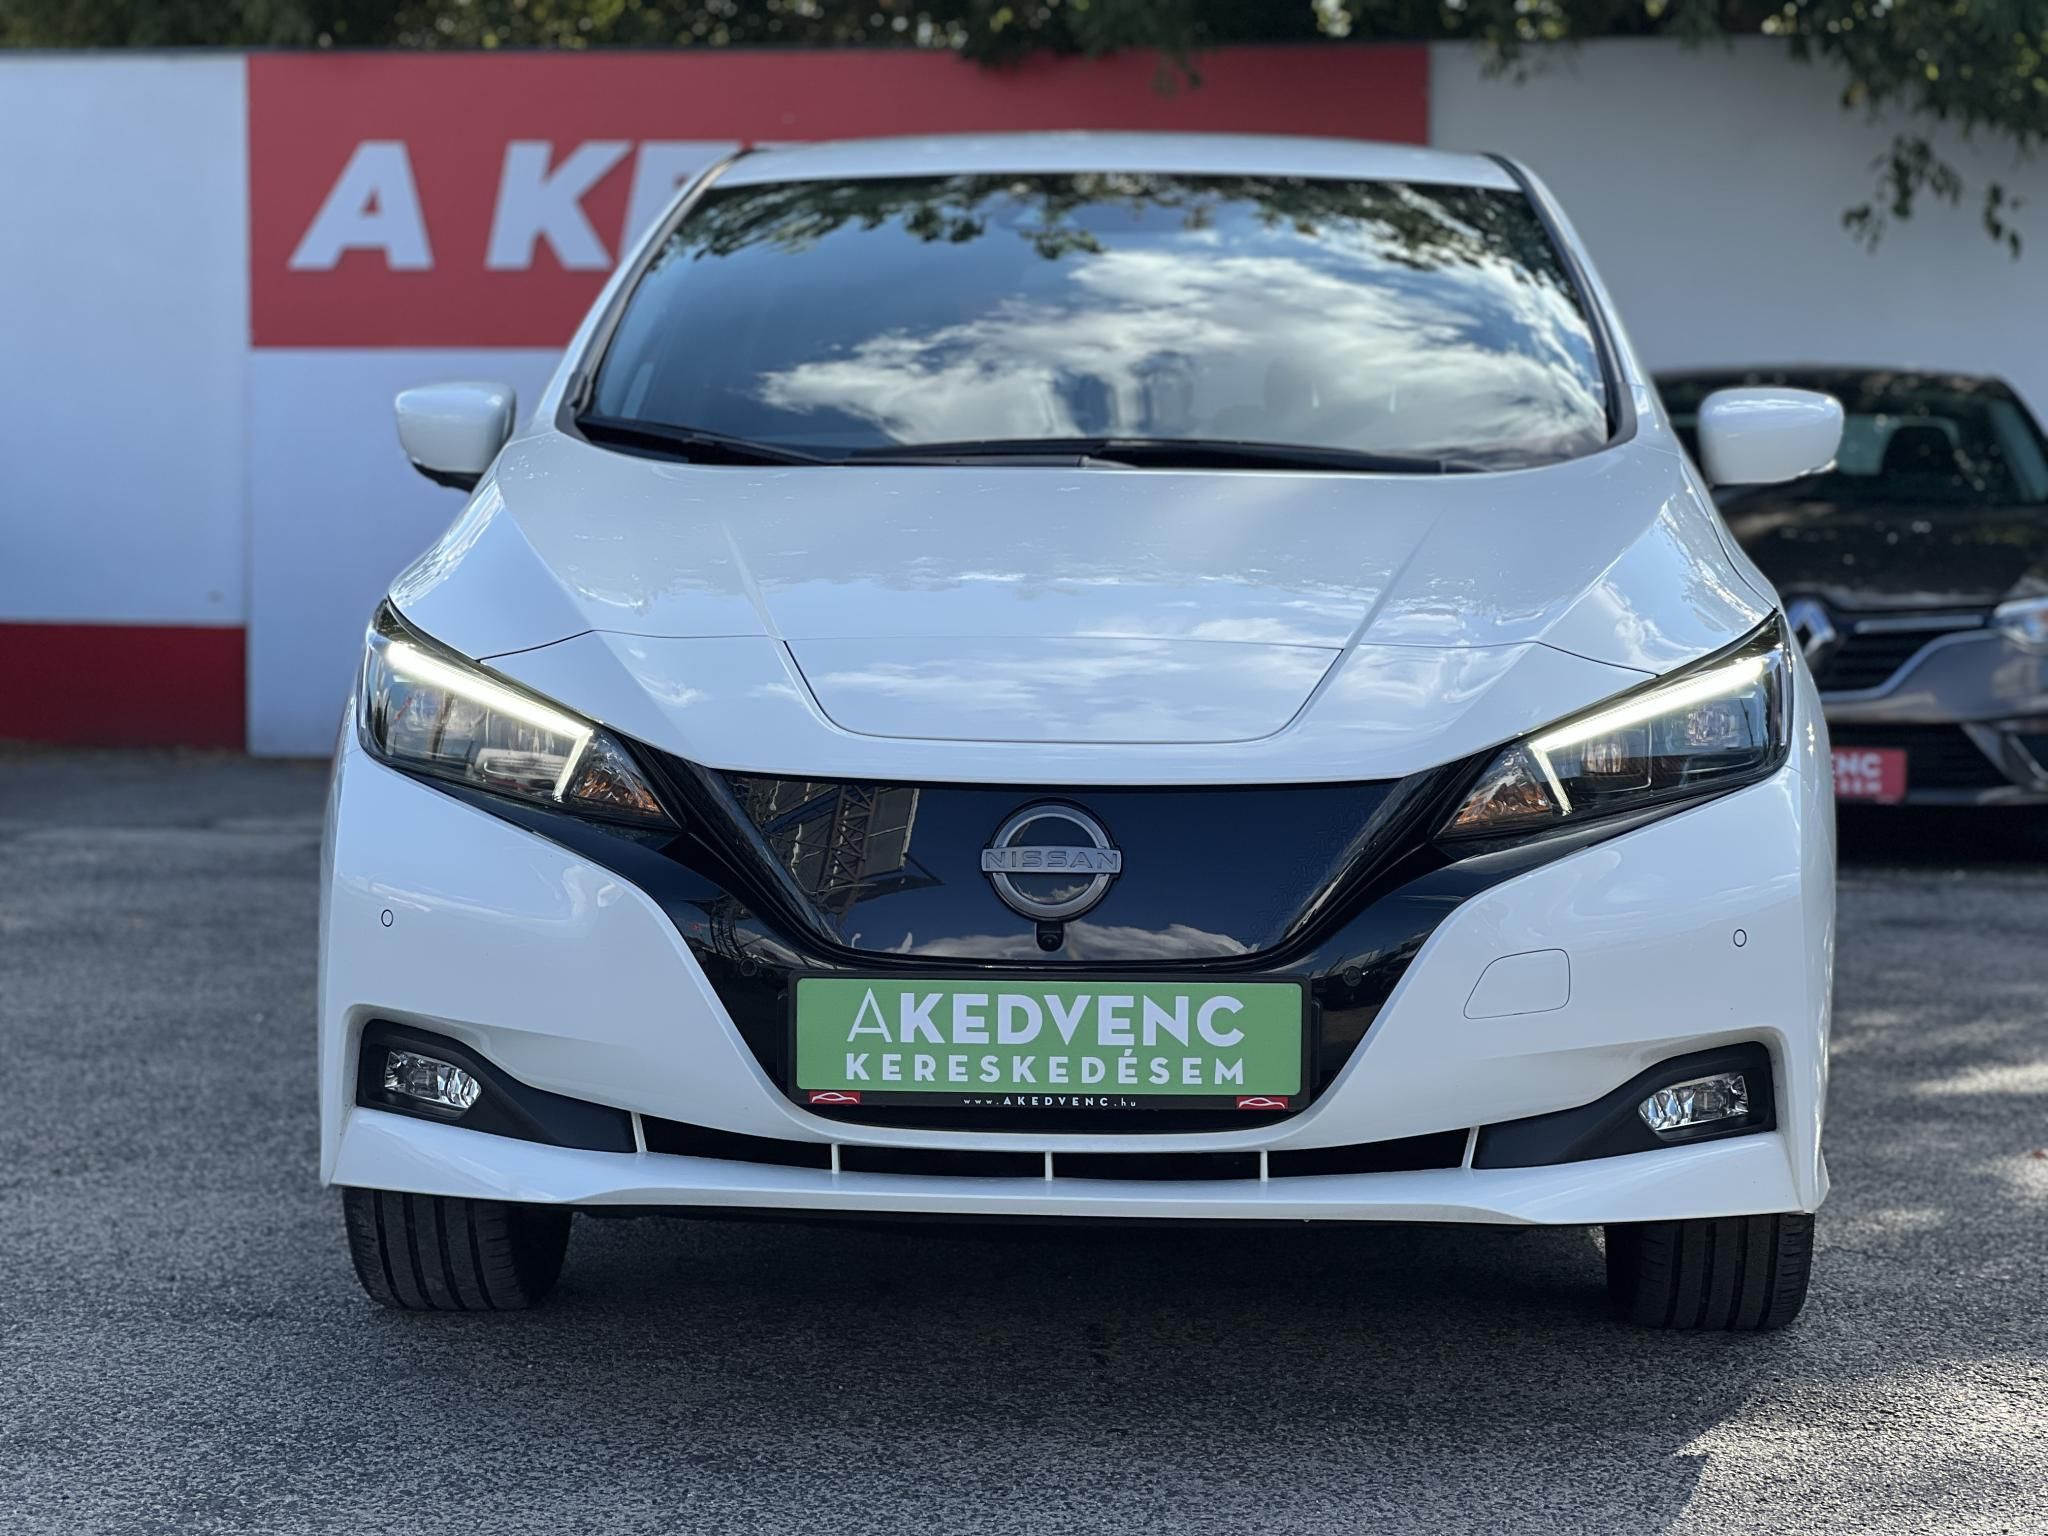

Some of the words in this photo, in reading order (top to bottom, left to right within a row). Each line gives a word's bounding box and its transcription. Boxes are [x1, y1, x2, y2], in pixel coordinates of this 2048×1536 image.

[288, 140, 434, 270] A
[985, 850, 1118, 870] NISSAN
[846, 1048, 1244, 1085] KERESKEDÉSEM
[963, 1096, 1137, 1107] www.AKEDVENC.hu
